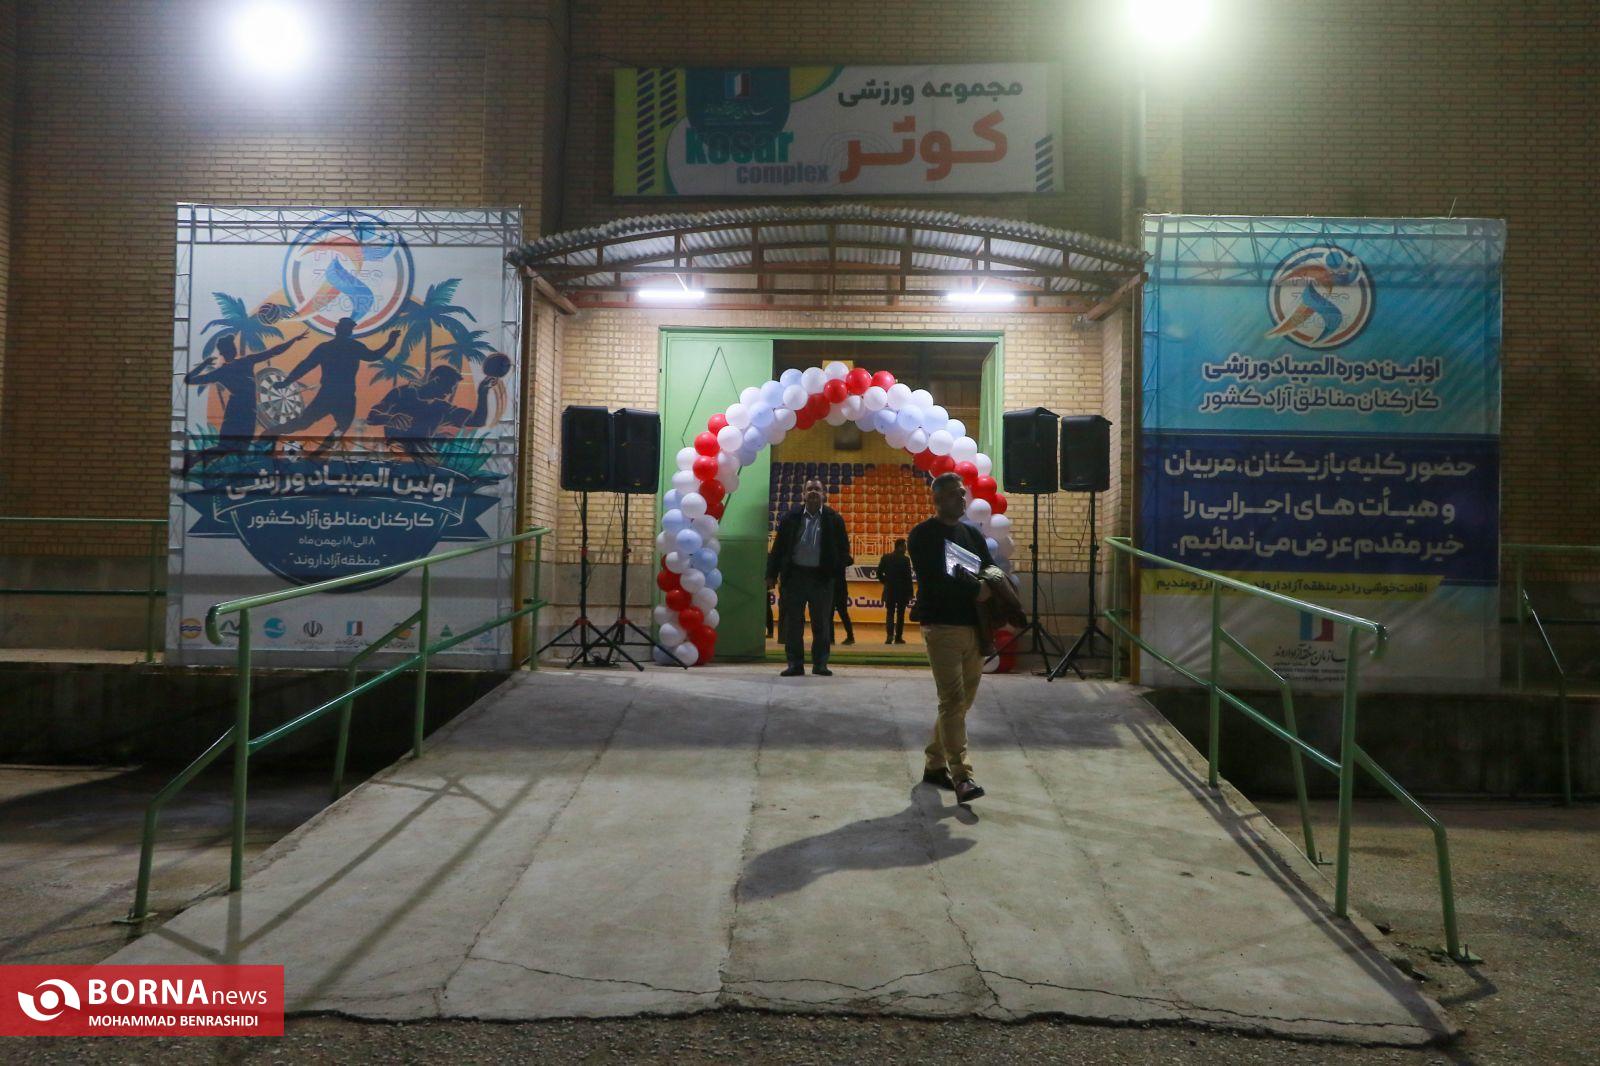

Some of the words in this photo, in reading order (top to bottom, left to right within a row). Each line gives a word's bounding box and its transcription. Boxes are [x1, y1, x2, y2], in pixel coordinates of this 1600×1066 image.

[837, 79, 916, 107] ورزشی
[920, 80, 1023, 104] مجموعه
[736, 160, 829, 186] complex
[1203, 355, 1270, 381] ورزشی
[1271, 355, 1335, 384] المپیاد
[1335, 361, 1378, 382] دوره
[1379, 358, 1441, 383] اولین
[1199, 386, 1261, 411] کشور
[1263, 385, 1293, 412] آزاد
[1293, 388, 1356, 412] مناطق
[1357, 389, 1440, 414] کارکنان
[1164, 449, 1236, 478] مربیان
[1347, 452, 1407, 481] کلیه
[1405, 456, 1477, 482] حضور
[224, 468, 306, 501] ورزشی
[307, 464, 391, 497] المپیاد
[391, 473, 456, 502] اولین
[1183, 490, 1197, 520] را
[1198, 491, 1292, 521] اجرایی
[1293, 492, 1356, 521] های
[1440, 503, 1456, 525] و
[246, 509, 297, 529] کشور
[296, 508, 320, 530] آزاد
[317, 510, 368, 530] مناطق
[367, 511, 435, 531] کارکنان
[298, 535, 314, 546] ماه
[1291, 530, 1353, 559] عرض
[1353, 531, 1421, 560] مقدم
[1419, 532, 1465, 562] خیر
[323, 551, 341, 569] آزاد
